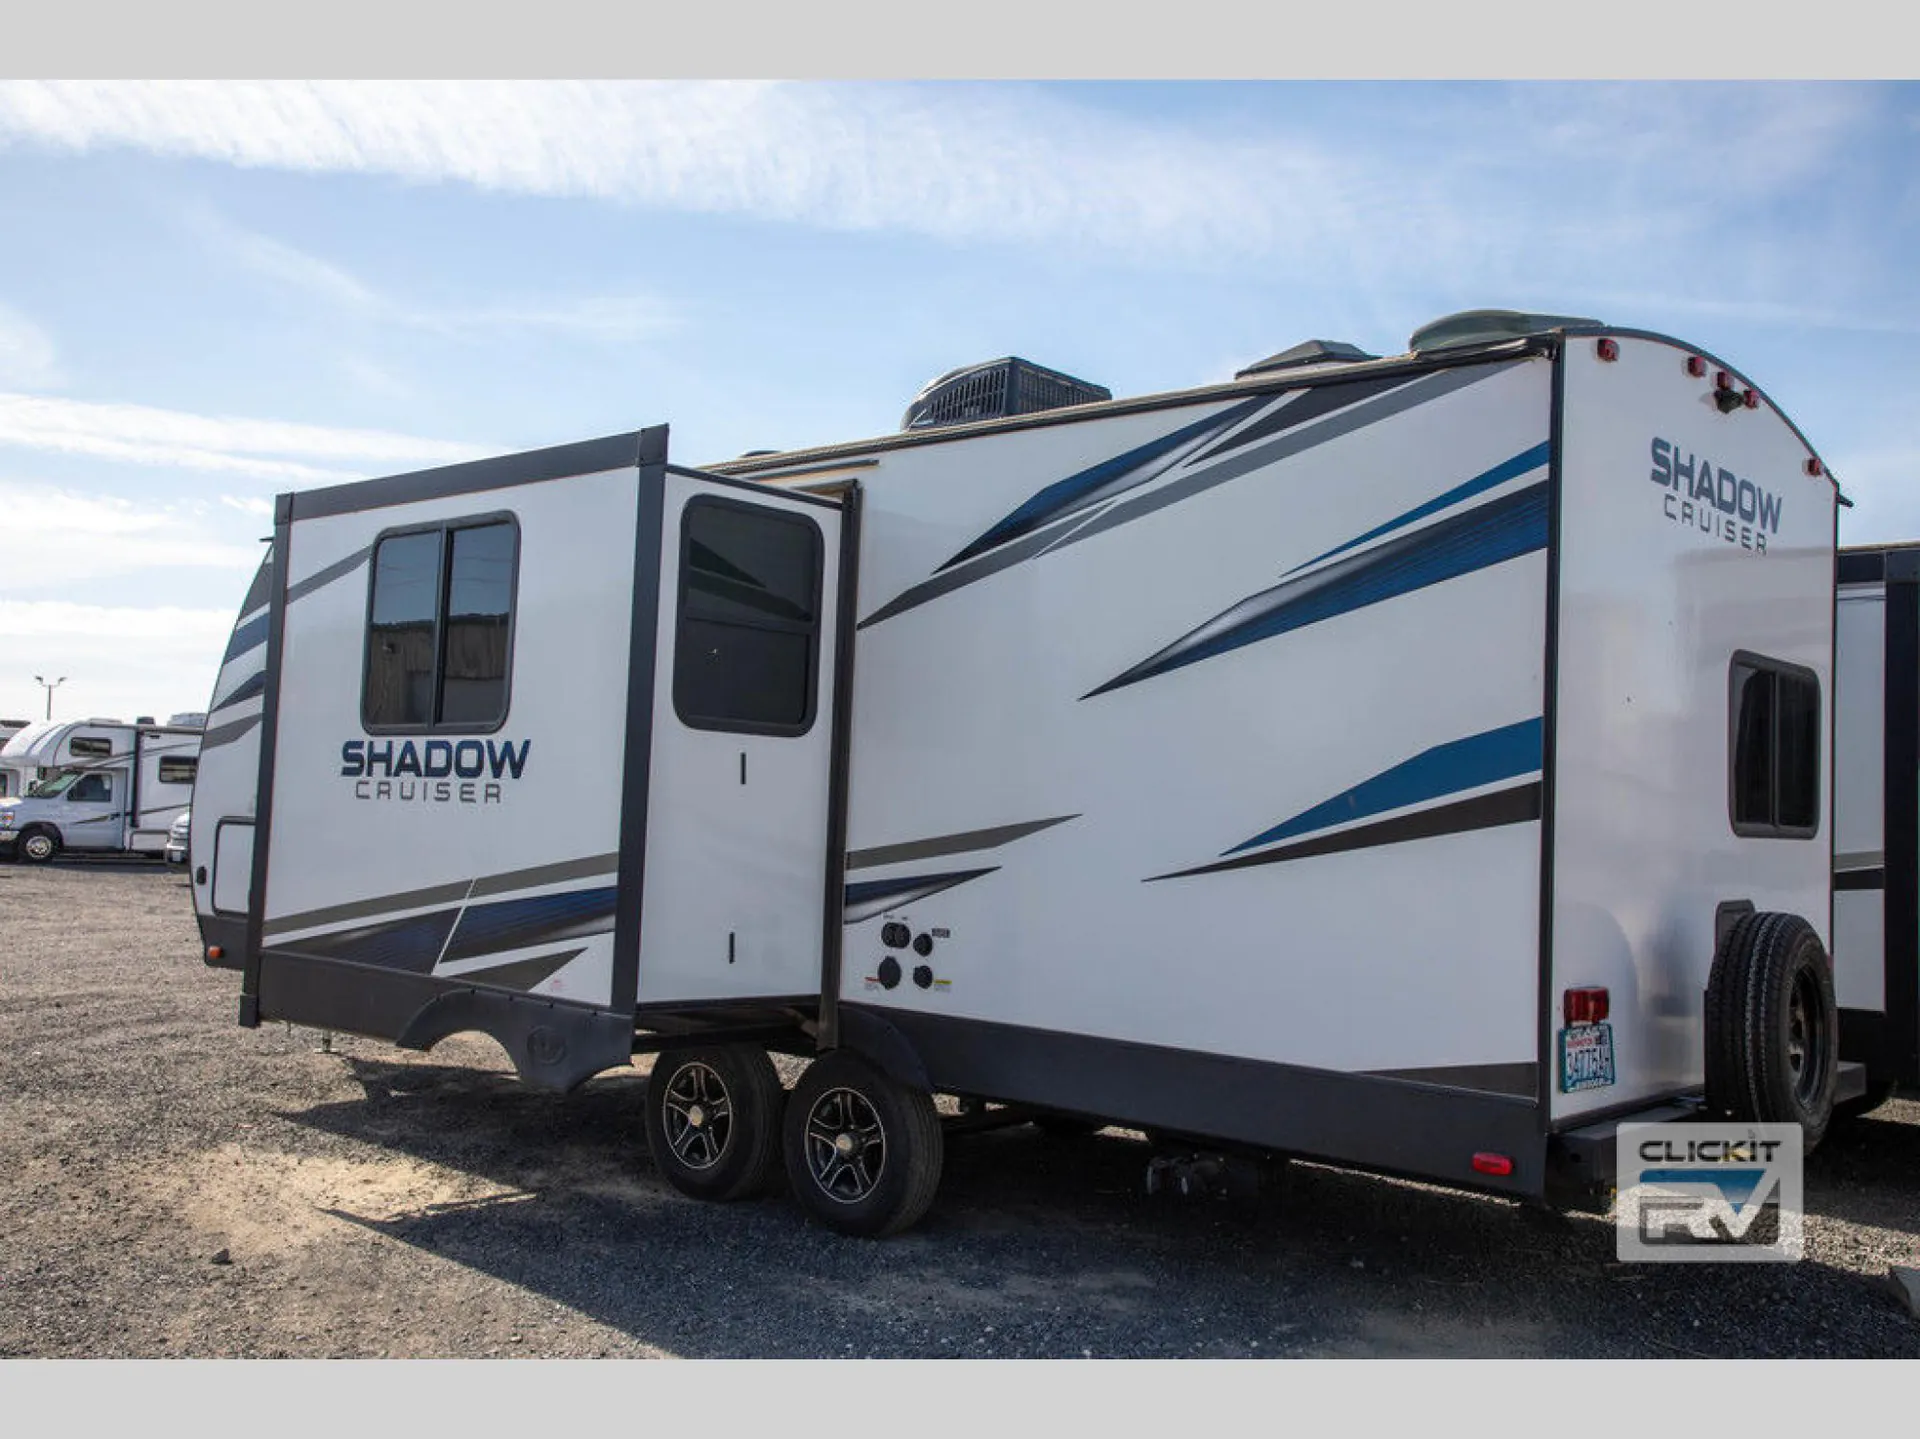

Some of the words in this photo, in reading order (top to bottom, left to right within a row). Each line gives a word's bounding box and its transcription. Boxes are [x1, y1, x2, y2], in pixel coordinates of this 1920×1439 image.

[1650, 436, 1782, 534] SHADOW
[1664, 493, 1767, 556] CRUISER
[341, 739, 532, 780] SHADOW
[355, 781, 502, 804] CRUISER
